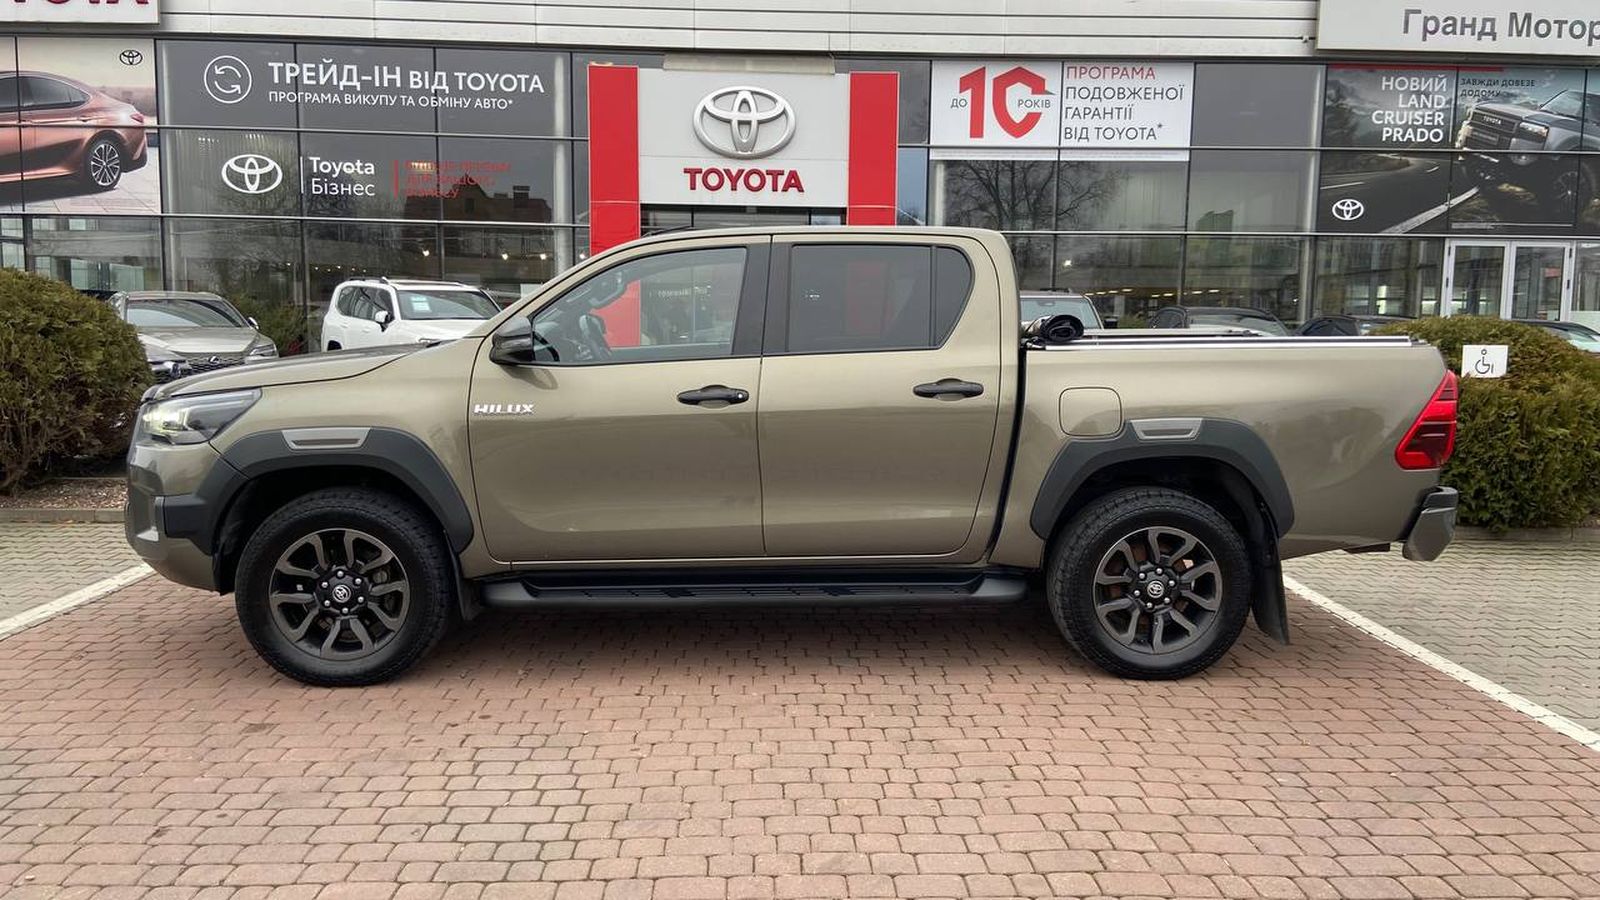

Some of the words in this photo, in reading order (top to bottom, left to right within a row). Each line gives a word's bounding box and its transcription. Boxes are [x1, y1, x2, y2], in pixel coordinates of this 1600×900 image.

[1403, 9, 1497, 41] Гранд
[268, 58, 401, 91] ТРЕЙД-ІН
[409, 70, 449, 94] ВІД
[454, 72, 545, 93] TOYOTA
[1067, 66, 1156, 79] ПРОГРАМА
[1381, 75, 1447, 92] НОВИЙ
[1460, 78, 1500, 87] ЗАВЖДИ
[1501, 79, 1536, 88] ДОВЕЗЕ
[268, 91, 341, 103] ПРОГРАМА
[344, 94, 397, 106] ВИКУПУ
[400, 95, 415, 107] ТА
[418, 96, 471, 109] ОБМІНУ
[1065, 84, 1185, 102] ПОДОВЖЕНОЇ
[1398, 94, 1446, 108] LAND
[1460, 89, 1501, 98] ДОДОМУ
[951, 98, 968, 109] ДО
[959, 66, 1046, 139] 10
[1017, 99, 1051, 109] РОКІВ
[1064, 104, 1134, 120] ГАРАНТІЇ
[1371, 110, 1444, 126] CRUISER
[1064, 127, 1089, 142] ВІД
[1382, 127, 1443, 143] PRADO
[308, 156, 375, 177] Toyota
[311, 178, 375, 196] Бізнес
[683, 167, 805, 193] TOYOTA
[473, 404, 534, 414] HILUX
